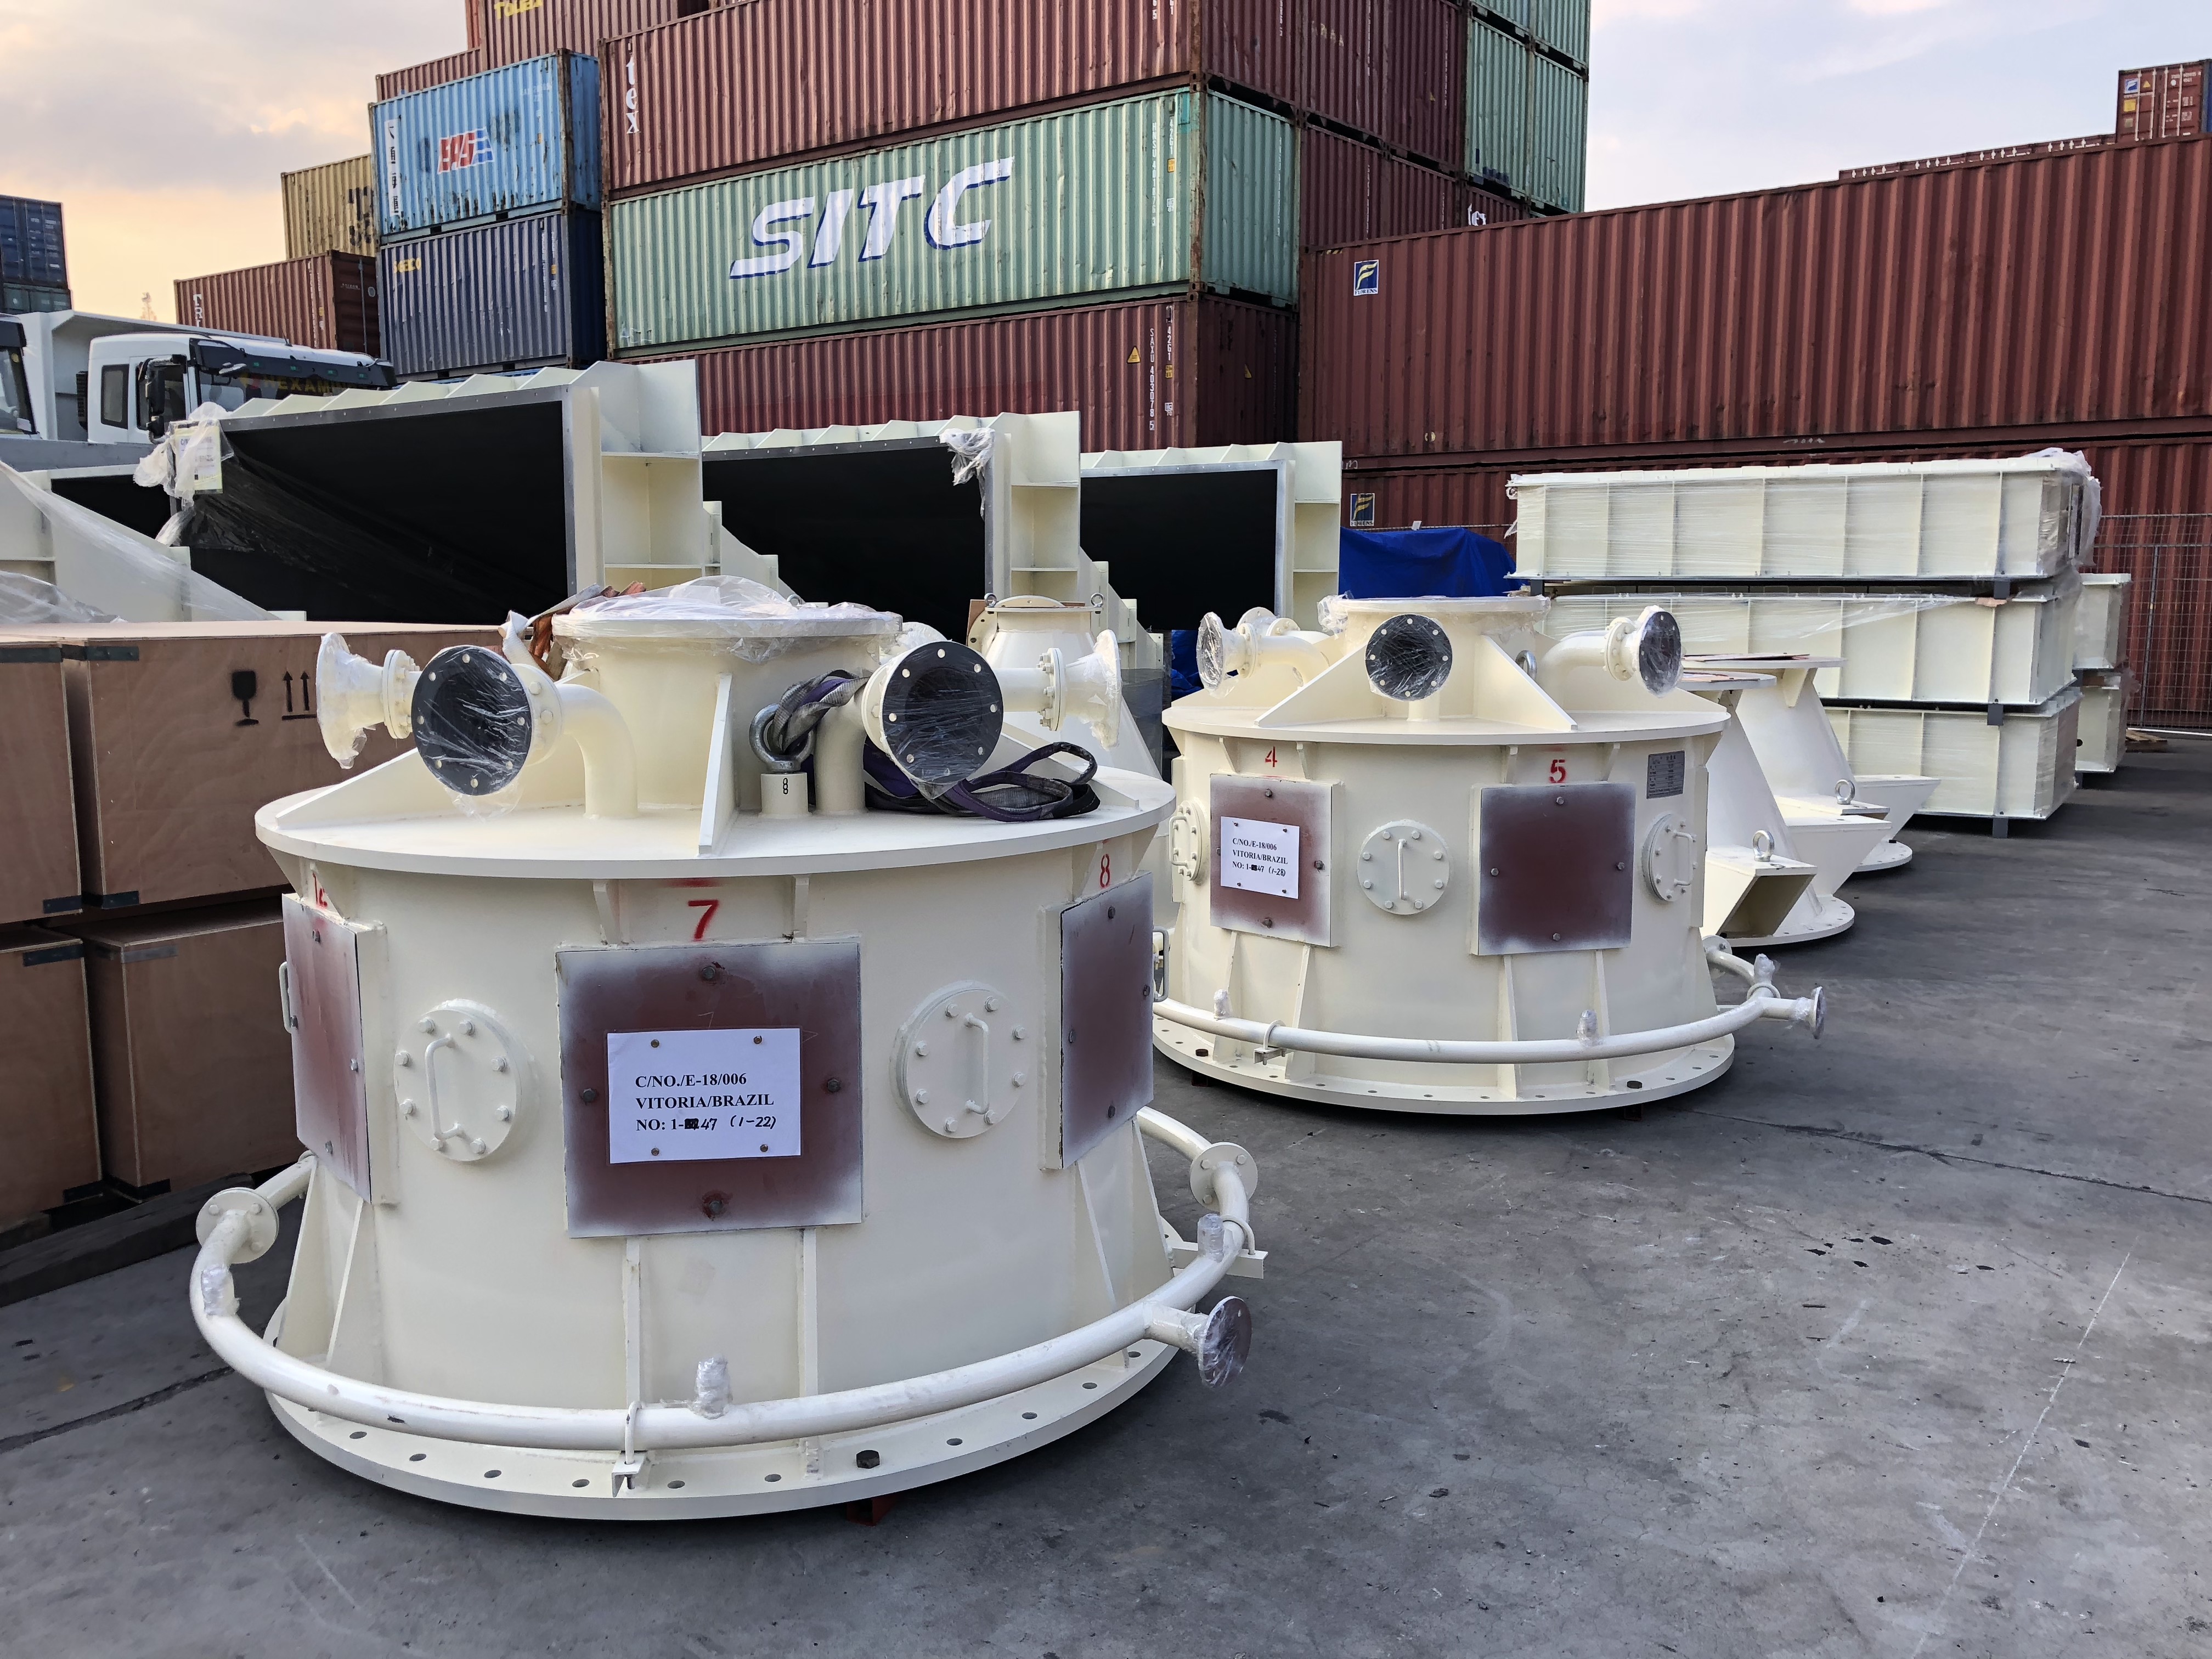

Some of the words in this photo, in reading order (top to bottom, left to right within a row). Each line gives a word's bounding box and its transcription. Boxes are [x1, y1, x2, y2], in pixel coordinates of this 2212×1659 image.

[626, 57, 639, 134] tex
[729, 156, 1015, 279] SITC
[1152, 217, 1156, 226] 3
[1149, 421, 1155, 430] 5
[1265, 746, 1278, 768] 4
[1549, 759, 1566, 783] 5
[1232, 838, 1277, 851] C/NO./E-18/006
[1232, 849, 1288, 865] VITORIA/BRAZIL
[1099, 853, 1110, 888] 8
[1232, 861, 1244, 870] NO:
[688, 899, 719, 940] 7
[635, 1073, 747, 1088] C/NO./E-18/006
[635, 1093, 775, 1109] VITORIA/BRAZIL
[636, 1119, 665, 1131] NO:
